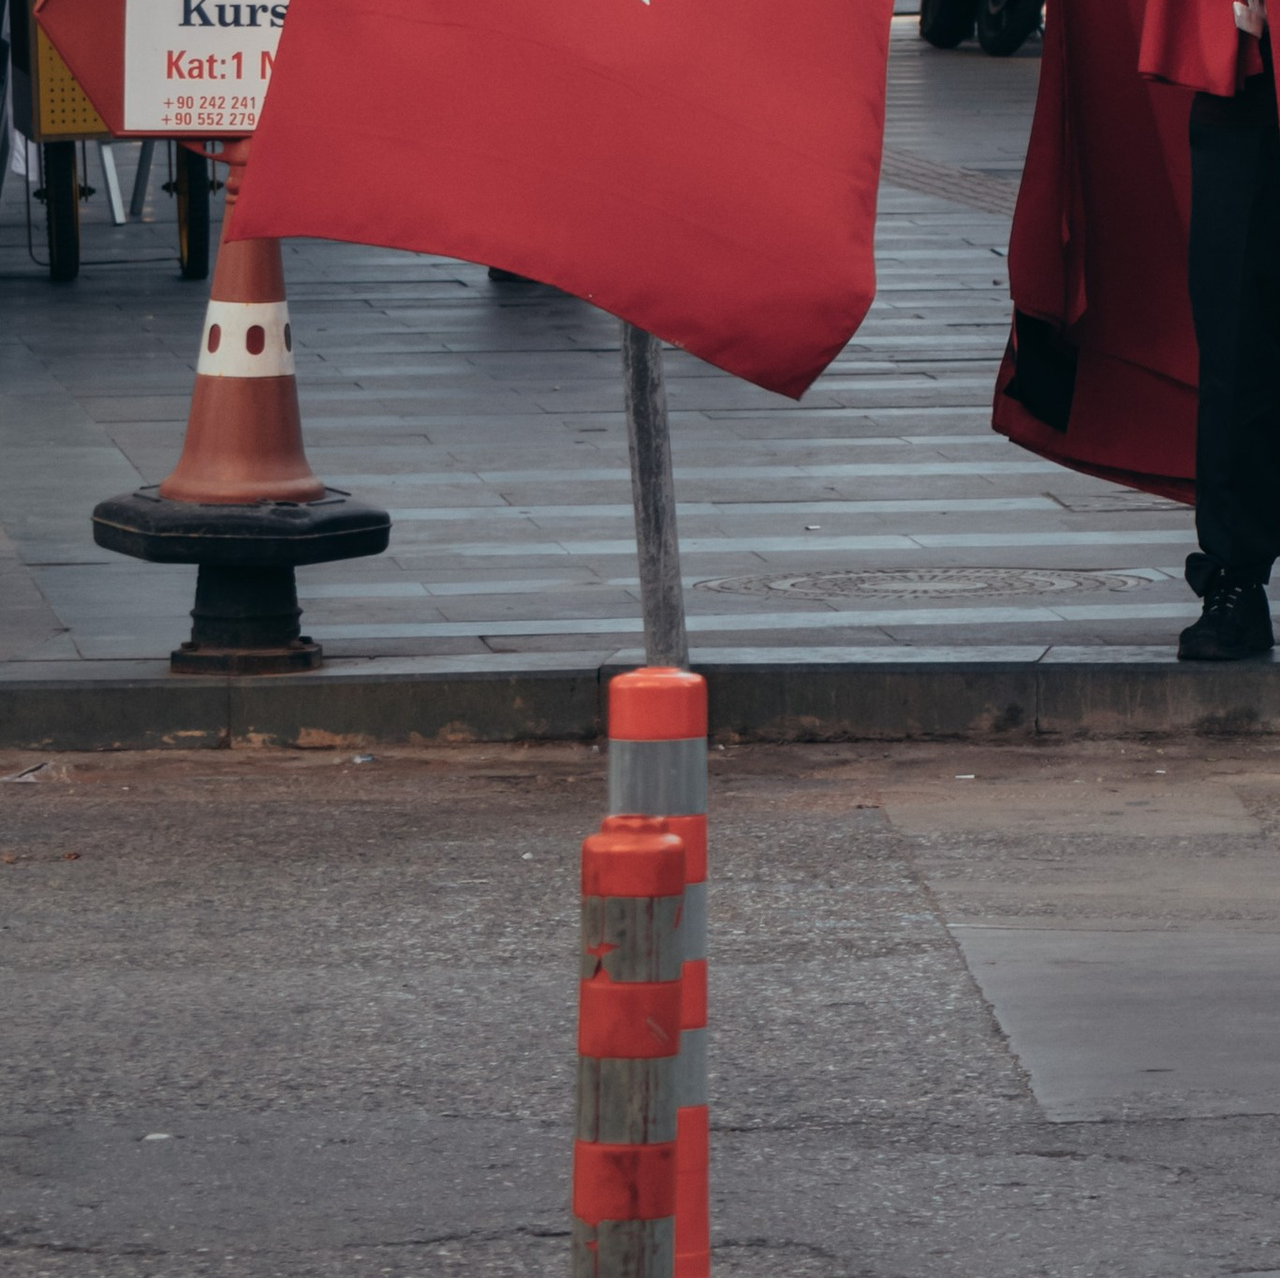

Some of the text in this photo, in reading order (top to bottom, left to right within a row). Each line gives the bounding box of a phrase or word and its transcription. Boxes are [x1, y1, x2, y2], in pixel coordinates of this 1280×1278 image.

[166, 50, 243, 80] Kat:1
[163, 95, 256, 110] +90 242 241
[161, 112, 256, 126] +90 552 279
